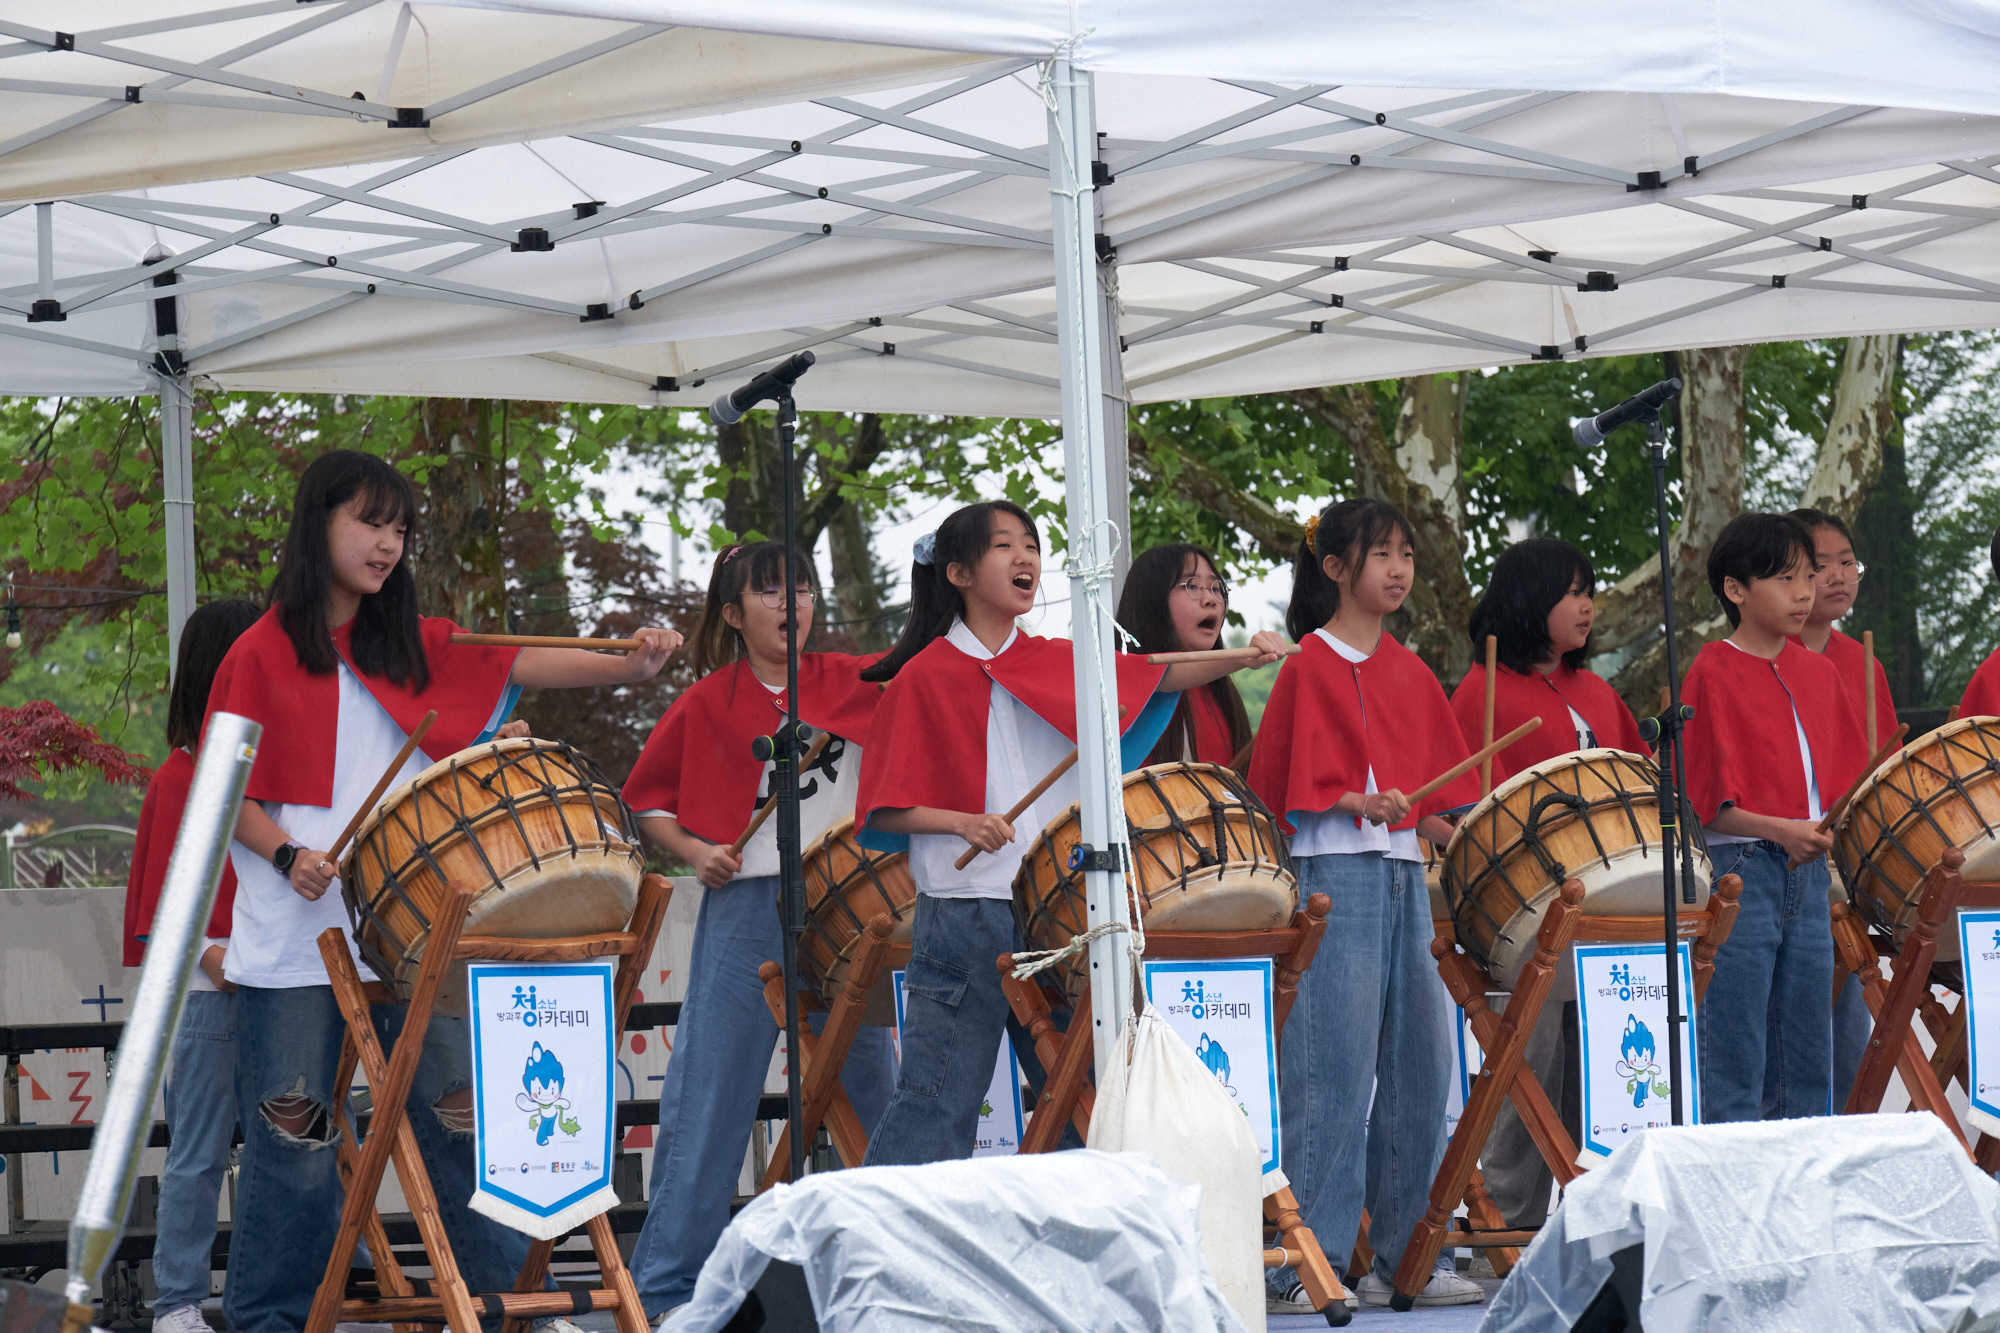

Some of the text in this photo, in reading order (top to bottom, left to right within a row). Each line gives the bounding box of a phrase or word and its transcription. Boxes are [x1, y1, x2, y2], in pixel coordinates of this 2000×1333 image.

[1598, 987, 1619, 997] 방과후
[1609, 964, 1646, 1001] 청소년
[511, 985, 557, 1027] 청소년
[1168, 1003, 1251, 1019] 방과후 아카데미
[1181, 980, 1222, 1019] 청소년
[497, 1010, 589, 1027] 방과후 아카데미
